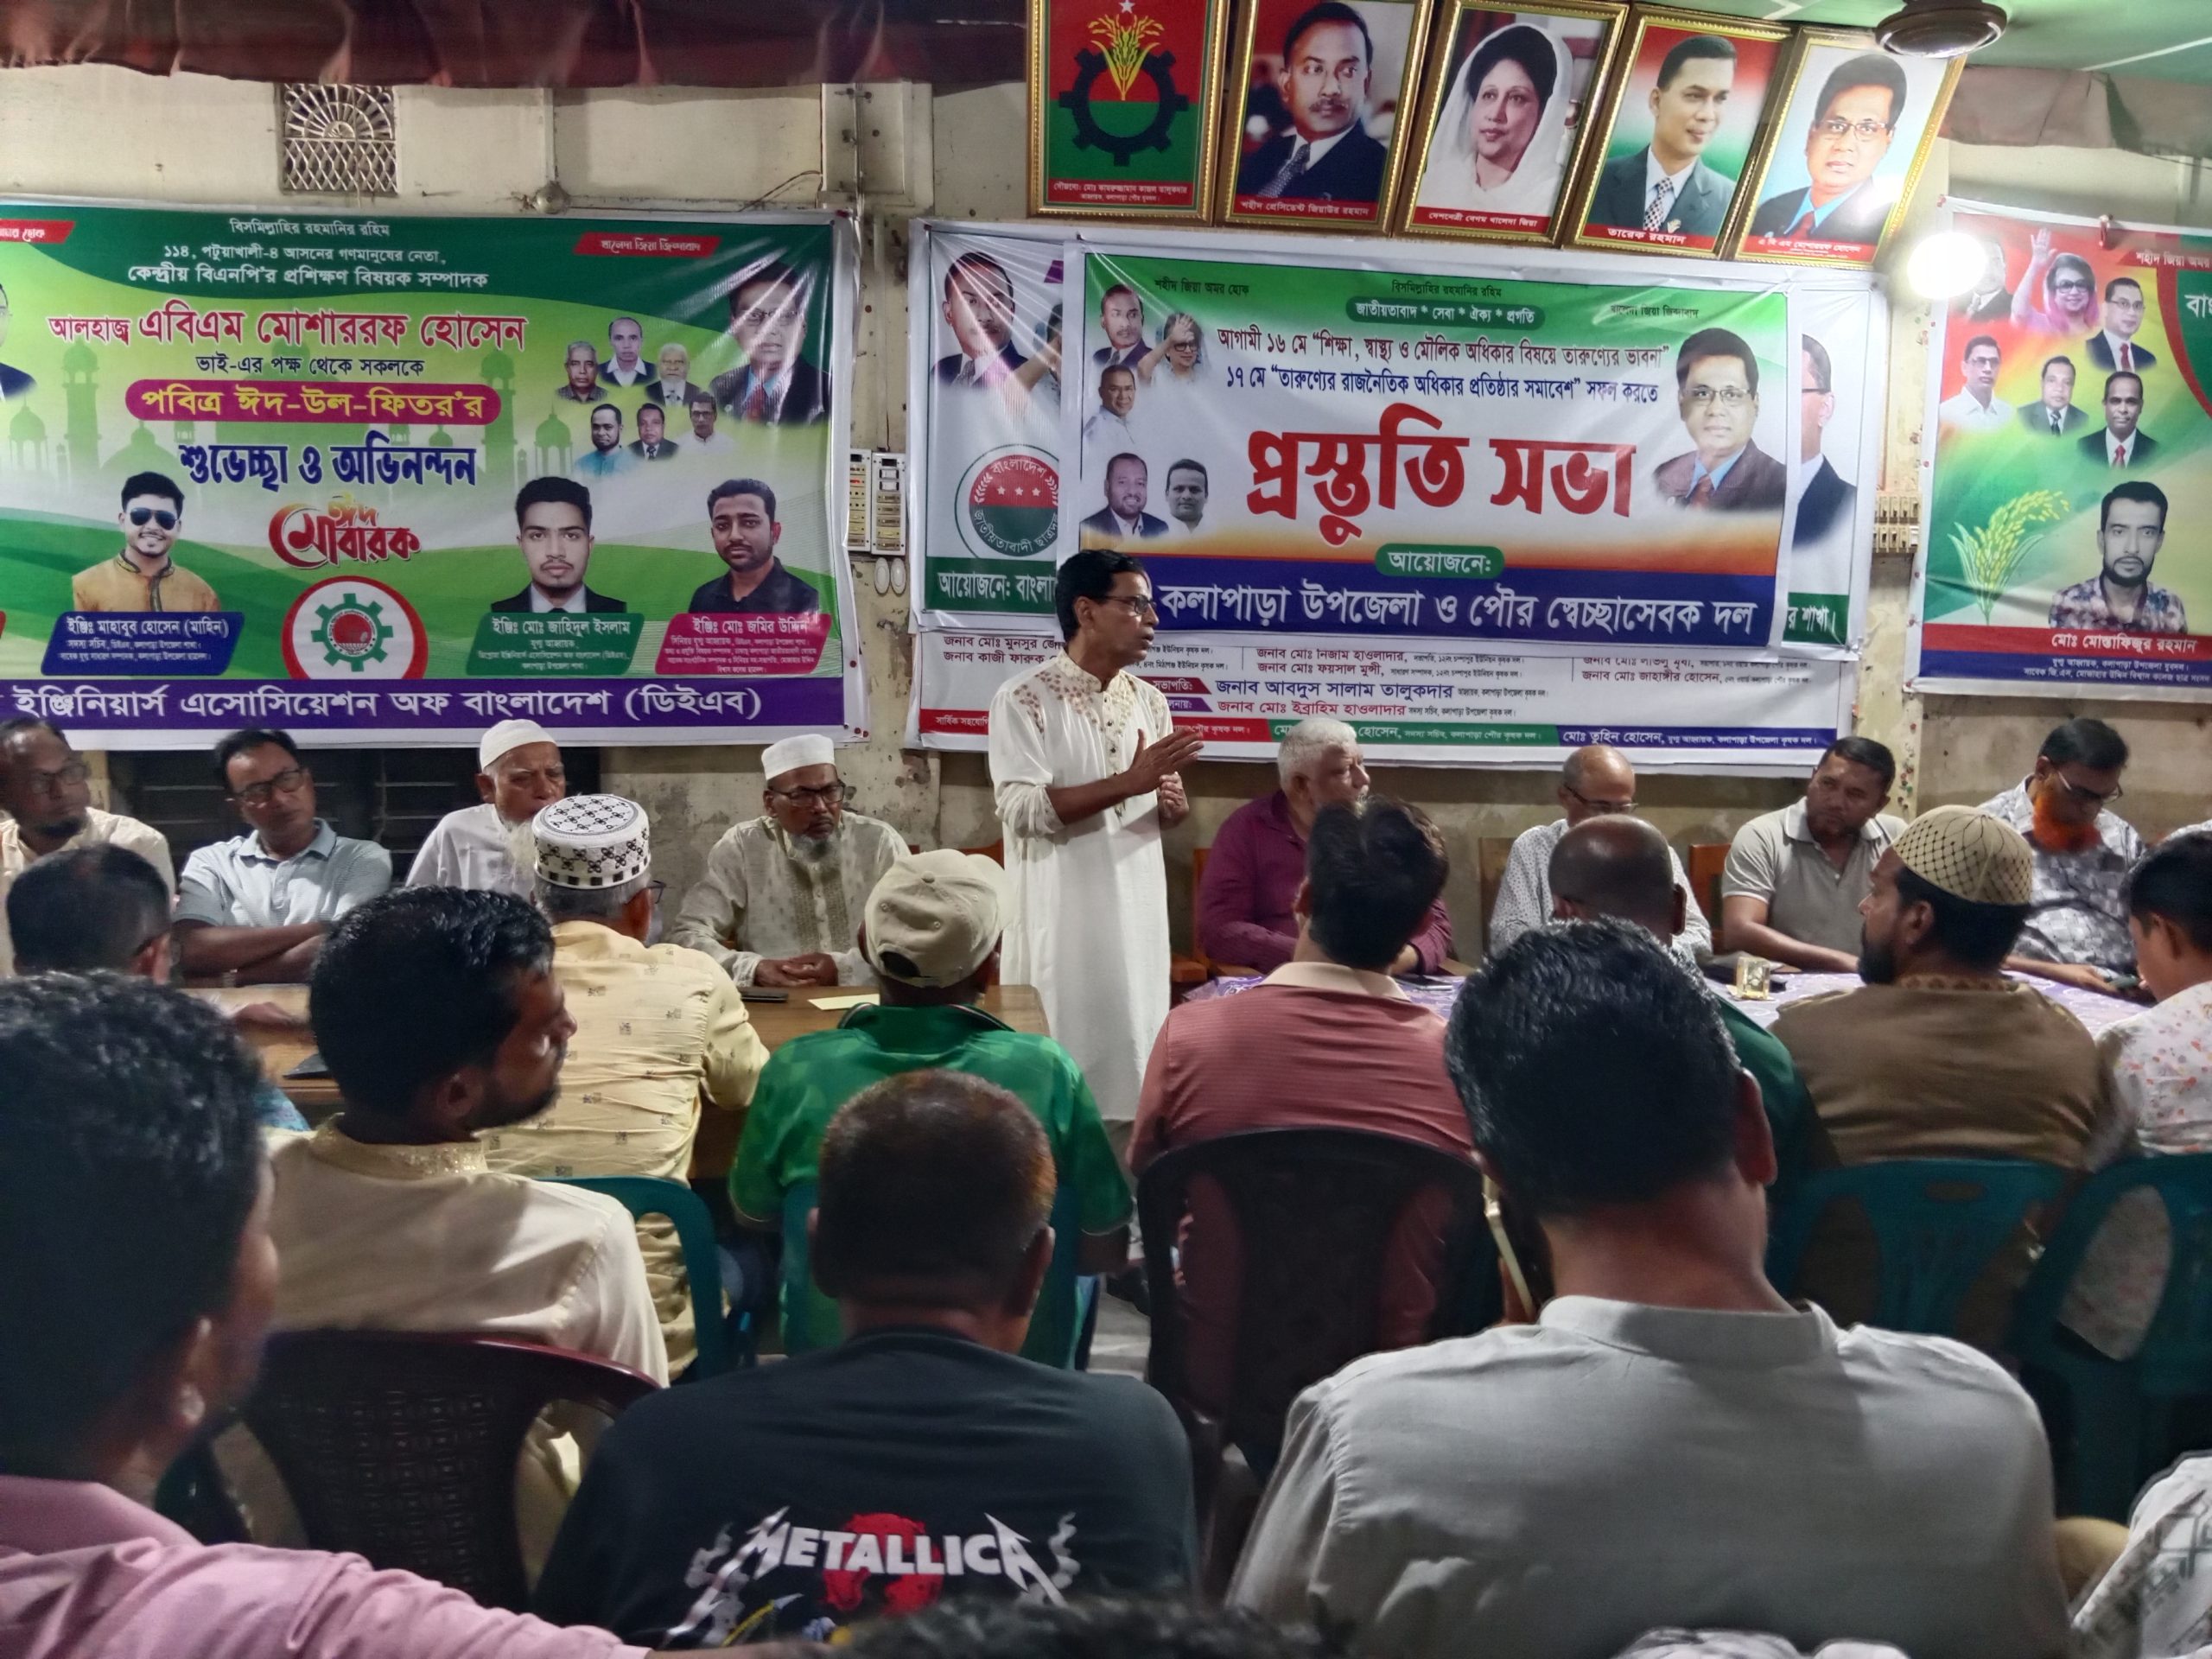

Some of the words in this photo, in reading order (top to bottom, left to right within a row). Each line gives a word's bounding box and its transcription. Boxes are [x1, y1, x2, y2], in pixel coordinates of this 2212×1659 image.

[304, 220, 355, 237] রহমানির
[359, 221, 391, 237] রহিম
[1607, 227, 1647, 240] তারেক
[1649, 232, 1687, 245] রহমান
[283, 247, 334, 260] আসনের
[2136, 248, 2160, 267] শহীদ
[128, 261, 189, 284] কেন্দ্রীয়
[283, 264, 349, 285] প্রশিক্ষণ
[354, 266, 413, 287] বিষয়ক
[417, 271, 490, 289] সম্পাদক
[1154, 276, 1178, 291] শহীদ
[1181, 277, 1201, 293] জিয়া
[1205, 282, 1225, 295] অমর
[1228, 283, 1250, 296] হোক
[1442, 283, 1478, 297] রহমানির
[1481, 285, 1503, 297] রহিম
[1355, 299, 1417, 319] জাতীয়তাবাদ
[1432, 306, 1455, 321] সেবা
[1469, 305, 1493, 323] ঐক্য
[1506, 308, 1535, 325] প্রগতি
[139, 300, 245, 345] এবিএম
[257, 310, 410, 347] মোশাররফ
[420, 313, 528, 351] হোসেন
[1217, 324, 1262, 353] আগামী
[1267, 333, 1286, 353] ১৬
[1292, 334, 1307, 355] মে
[1363, 335, 1394, 364] স্বাস্থ্য
[1398, 340, 1409, 359] ও
[1414, 334, 1461, 363] মৌলিক
[1465, 335, 1514, 365] অধিকার
[1519, 338, 1556, 365] বিষয়ে
[1561, 345, 1619, 367] তারুণ্যের
[195, 353, 263, 376] ভাই-এর
[272, 355, 302, 375] পক্ষ
[309, 356, 353, 376] থেকে
[359, 358, 424, 377] সকলকে
[1227, 365, 1244, 388] ১৭
[1249, 366, 1267, 388] মে
[1340, 366, 1409, 395] রাজনৈতিক
[1414, 369, 1465, 397] অধিকার
[1469, 371, 1519, 398] প্রতিষ্ঠার
[1586, 380, 1618, 401] সফল
[1622, 382, 1659, 404] করতে
[141, 383, 222, 415] পবিত্র
[178, 442, 289, 492] শুভেচ্ছা
[298, 446, 323, 485] ও
[330, 429, 477, 486] অভিনন্দন
[990, 458, 1047, 478] বাংলাদেশ
[1246, 403, 1471, 546] প্রস্তুতি
[1488, 437, 1637, 518] সভা
[268, 503, 421, 569] মোবারক
[974, 509, 1033, 553] জাতীয়তাবাদী
[1015, 574, 1058, 603] বাংলা
[1156, 582, 1294, 627] কলাপাড়া
[1300, 578, 1427, 627] উপজেলা
[1436, 593, 1459, 625] ও
[1468, 581, 1541, 629] পৌর
[1548, 594, 1705, 637] স্বেচ্ছাসেবক
[1712, 599, 1758, 638] দল
[141, 620, 181, 635] হোসেন
[184, 616, 229, 639] (মাহিন)
[522, 620, 544, 635] মোঃ
[548, 617, 591, 638] জাহিদুল
[593, 618, 632, 635] ইসলাম
[721, 620, 743, 635] মোঃ
[747, 617, 774, 635] জমির
[944, 636, 975, 647] জনাব
[978, 637, 1001, 648] মোঃ
[1005, 638, 1038, 652] মুনসুর
[1256, 648, 1287, 659] জনাব
[1290, 648, 1313, 659] মোঃ
[2051, 632, 2077, 647] মোঃ
[2082, 632, 2152, 654] মোস্তাফিজুর
[2156, 638, 2198, 654] রহমান
[944, 651, 973, 663] জনাব
[978, 650, 1006, 664] কাজী
[1009, 653, 1046, 664] ফারুক
[1257, 663, 1287, 673] জনাব
[1291, 663, 1313, 674] মোঃ
[1317, 664, 1357, 675] ফয়সাল
[1582, 671, 1611, 681] জনাব
[1614, 671, 1635, 682] মোঃ
[1638, 669, 1681, 683] জাহাঙ্গীর
[13, 684, 171, 719] ইঞ্জিনিয়ার্স
[180, 684, 379, 719] এসোসিয়েশন
[390, 691, 451, 716] অফ
[462, 689, 613, 717] বাংলাদেশ
[625, 683, 762, 721] (ডিইএব)
[1216, 680, 1260, 695] জনাব
[1265, 680, 1321, 700] আবদুস
[1326, 682, 1376, 697] সালাম
[1381, 683, 1455, 702] তালুকদার
[1217, 701, 1255, 713] জনাব
[1259, 702, 1286, 714] মোঃ
[1291, 700, 1339, 716] ইব্রাহিম
[1343, 703, 1407, 716] হাওলাদার
[1563, 730, 1586, 742] মোঃ
[1589, 728, 1620, 745] তুহিন
[667, 1505, 1068, 1637] METALLICA
